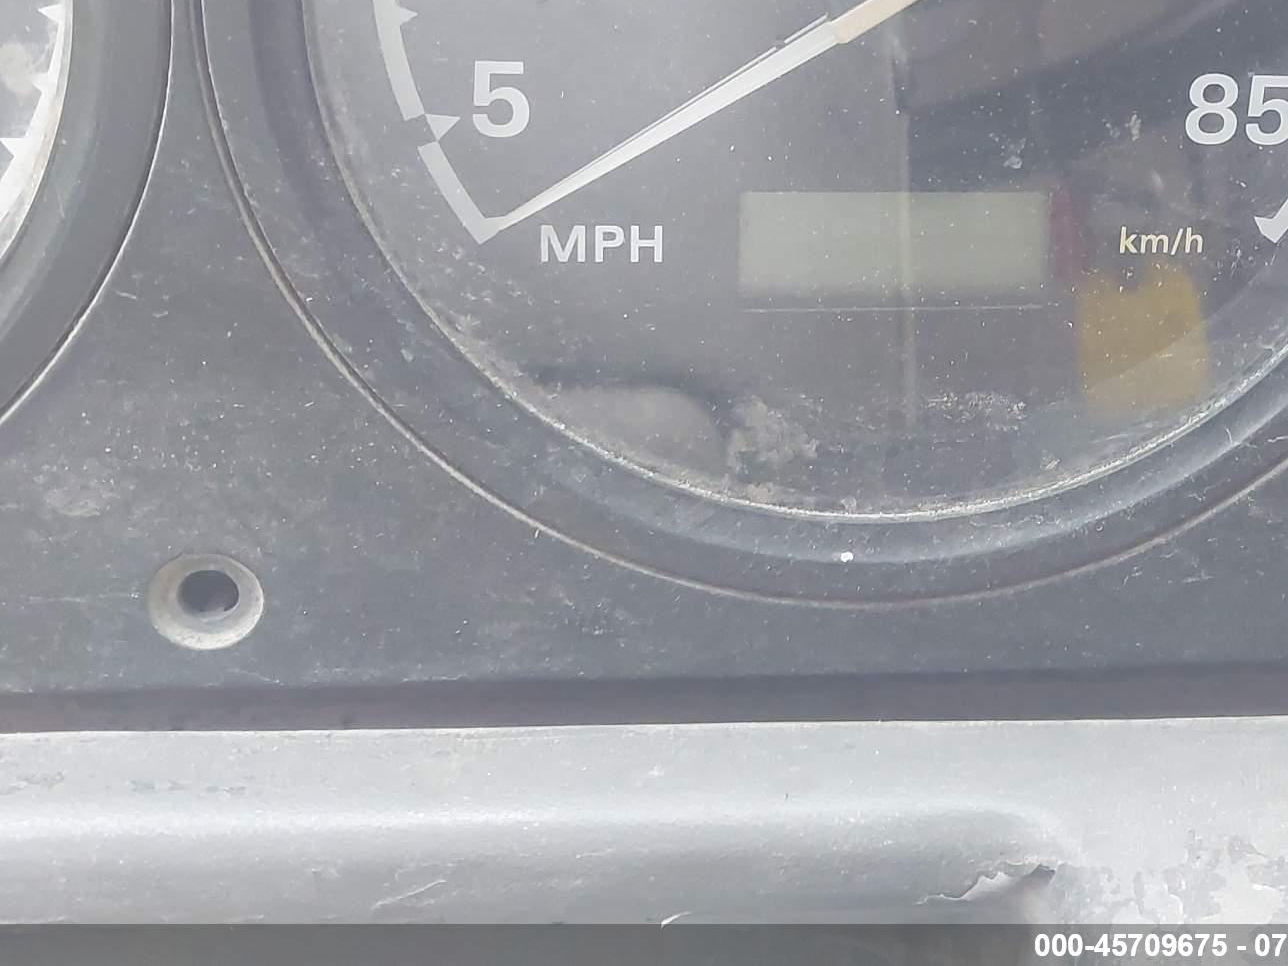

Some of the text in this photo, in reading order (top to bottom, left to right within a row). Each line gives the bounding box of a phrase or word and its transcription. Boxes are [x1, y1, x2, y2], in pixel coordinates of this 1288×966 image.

[472, 60, 531, 138] 5
[539, 225, 665, 264] MPH
[1118, 226, 1205, 255] km/h
